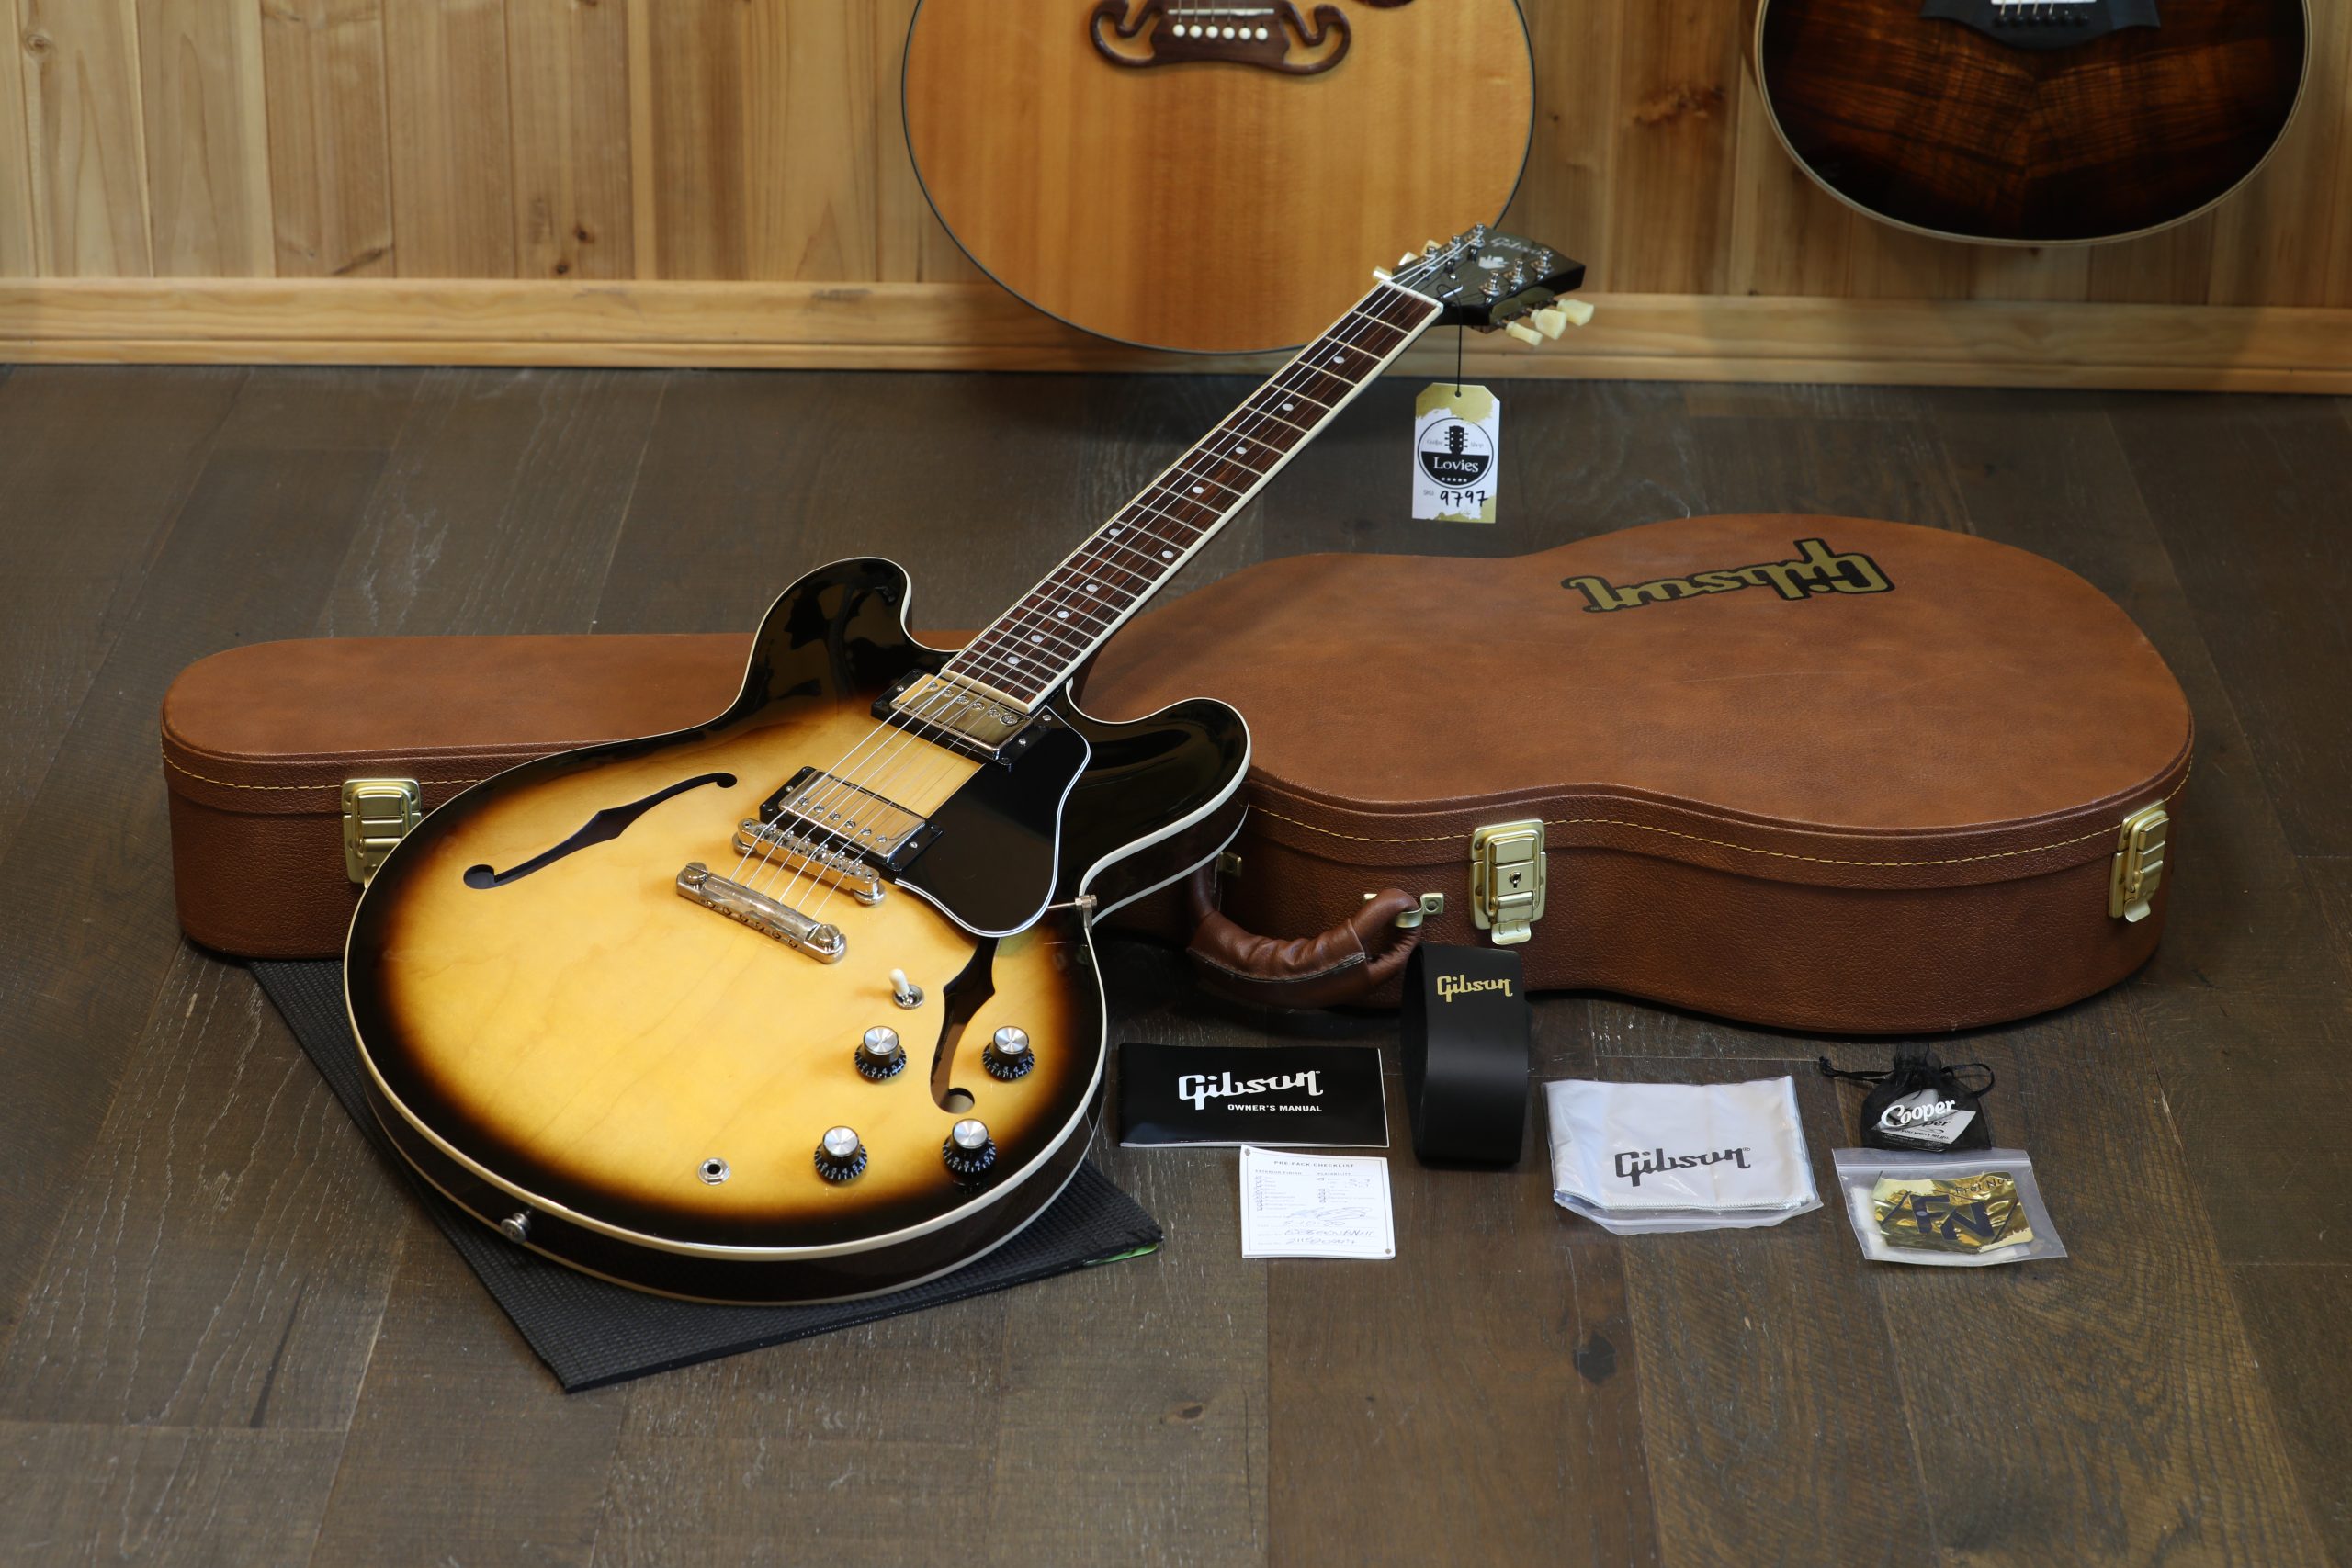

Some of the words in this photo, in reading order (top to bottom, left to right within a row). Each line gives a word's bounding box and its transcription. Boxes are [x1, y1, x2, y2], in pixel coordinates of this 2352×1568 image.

[1433, 457, 1479, 473] Lovies
[1440, 490, 1489, 508] 9797
[1562, 538, 1894, 613] Gibson
[1436, 974, 1513, 1003] Gibson
[1178, 1070, 1324, 1111] Gibson
[1227, 1103, 1276, 1111] OWNER'S
[1279, 1104, 1322, 1112] MANUAL
[1881, 1100, 1956, 1127] Cooper
[1614, 1148, 1751, 1187] Gibson
[1955, 1183, 1982, 1193] Fret
